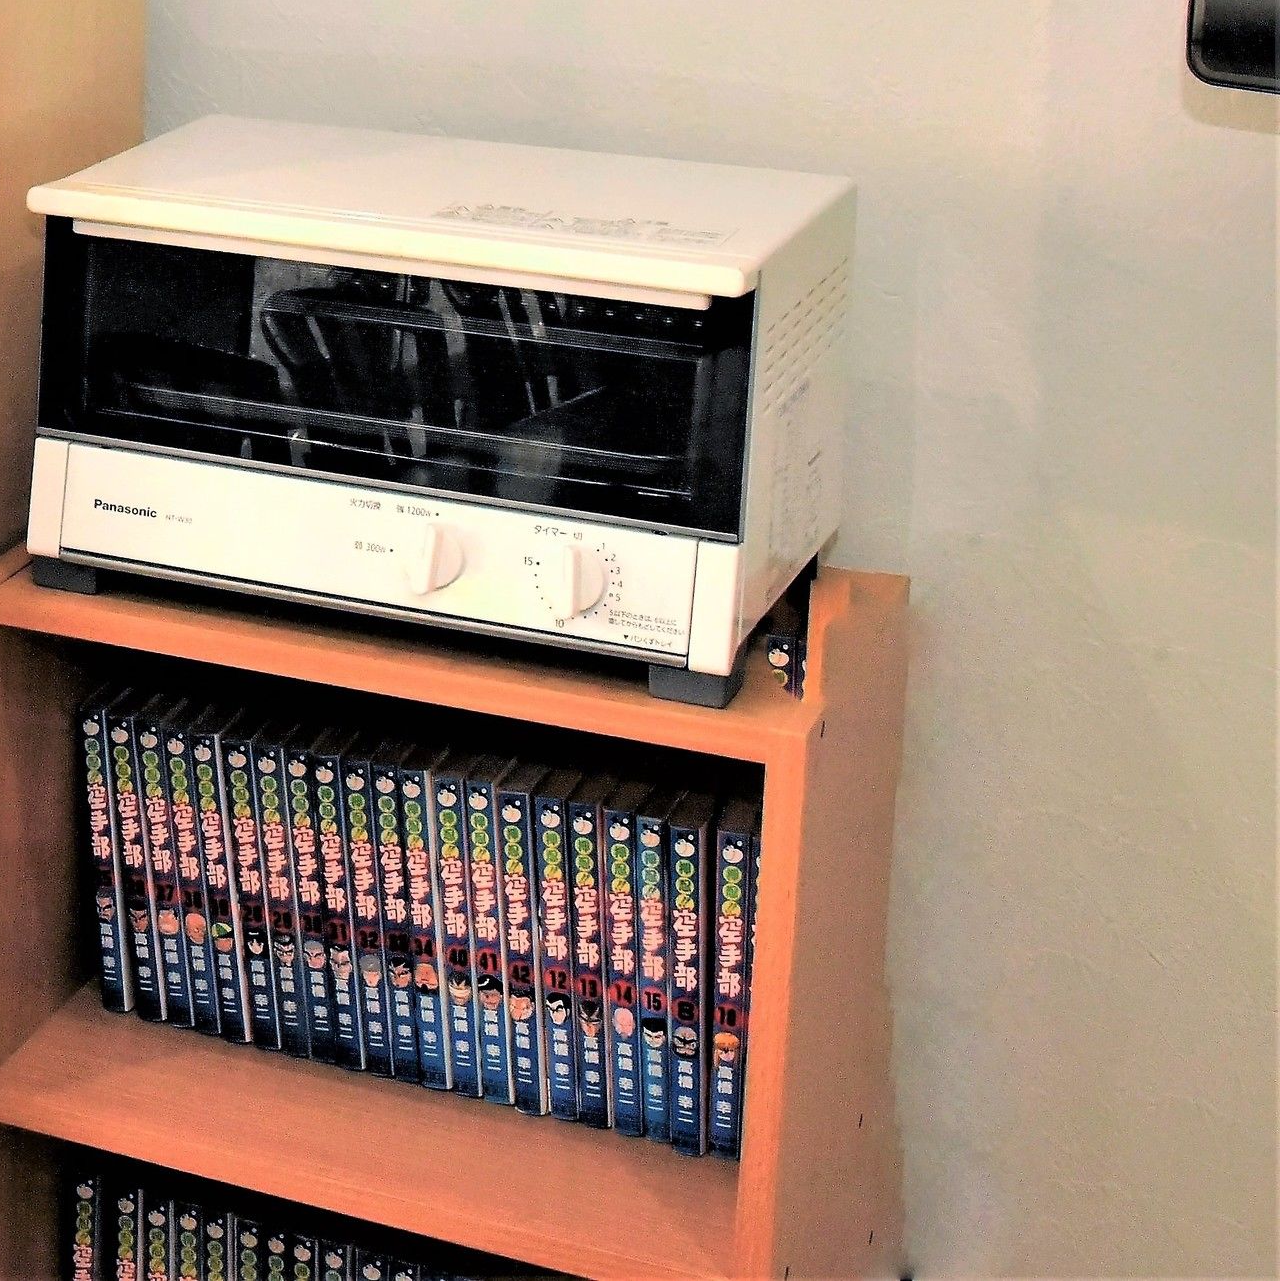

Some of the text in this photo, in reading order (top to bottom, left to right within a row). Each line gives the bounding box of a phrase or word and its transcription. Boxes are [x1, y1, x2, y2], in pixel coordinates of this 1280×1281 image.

[94, 498, 158, 519] Panasonic
[534, 525, 567, 537] タイマー
[524, 556, 533, 566] 15
[555, 618, 565, 629] 10
[479, 952, 497, 971] 41
[512, 964, 531, 983] 42
[549, 970, 567, 989] 12
[579, 978, 598, 997] 13
[614, 983, 632, 1004] 14
[644, 991, 662, 1011] 15
